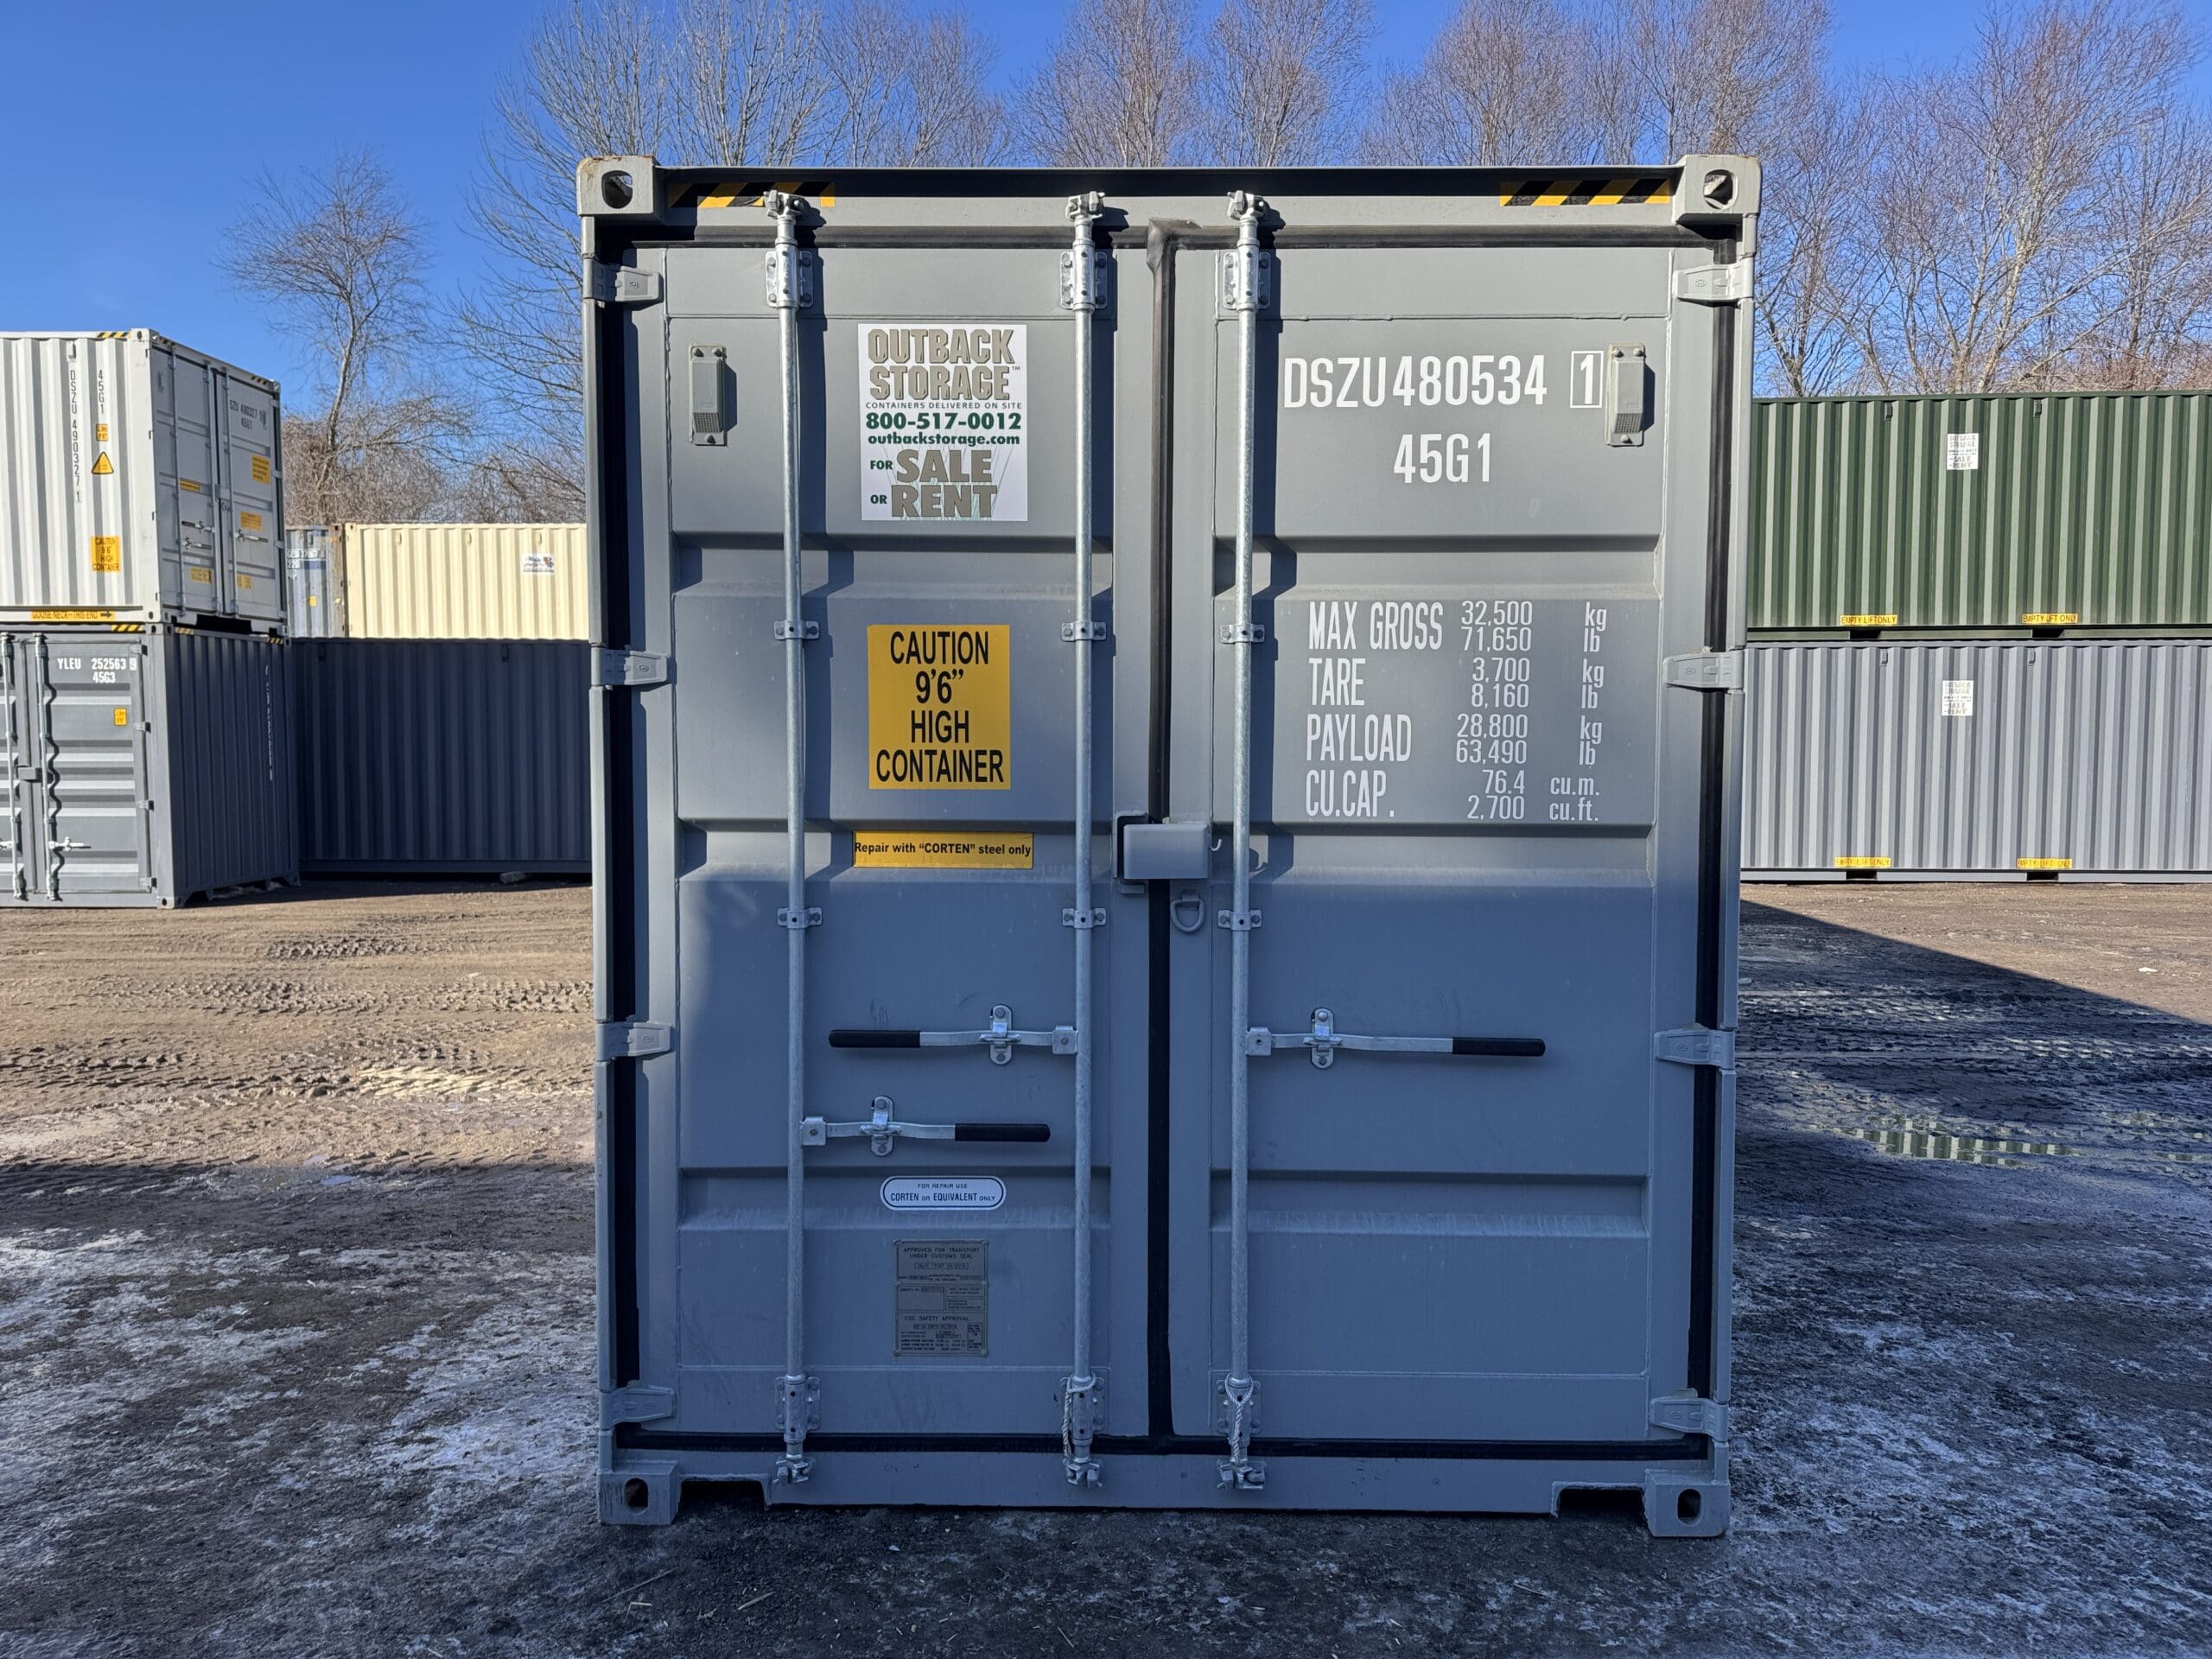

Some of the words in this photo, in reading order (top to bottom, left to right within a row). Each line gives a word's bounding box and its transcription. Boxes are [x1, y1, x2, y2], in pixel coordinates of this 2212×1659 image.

[868, 328, 1015, 364] OUTBACK
[869, 365, 1010, 400] STORAGE
[1580, 354, 1593, 404] 1
[866, 412, 1021, 429] 800-517-0012
[868, 432, 1020, 446] outbackstorage.com
[870, 461, 893, 470] FOR
[896, 449, 993, 483] SALE
[1394, 433, 1491, 483] 45G1
[870, 494, 887, 504] OR
[891, 485, 997, 518] RENT
[1308, 601, 1358, 650] MAX
[1370, 602, 1444, 650] GROSS
[1461, 601, 1533, 626] 32,500
[1585, 602, 1608, 631] kg
[1461, 626, 1532, 652] 71,650
[1583, 627, 1600, 652] lb
[57, 658, 81, 670] YLEU
[91, 658, 126, 670] 252563
[890, 631, 988, 664] CAUTION
[92, 671, 115, 683] 45G3
[1308, 658, 1366, 706] TARE
[1471, 657, 1530, 683] 3,700
[1582, 658, 1605, 688] kg
[1471, 683, 1529, 709] 8,160
[1581, 684, 1599, 709] lb
[911, 710, 969, 743] HIGH
[1306, 714, 1412, 762] PAYLOAD
[1457, 713, 1529, 739] 28,800
[1580, 715, 1603, 744] kg
[876, 749, 1004, 783] CONTAINER
[1456, 740, 1528, 765] 63,490
[1579, 741, 1596, 766] lb
[1482, 769, 1525, 795] 76.4
[1549, 776, 1599, 796] cu.m.
[1467, 795, 1525, 821] 2,700
[1549, 797, 1599, 821] cu.ft.
[855, 842, 889, 854] Repair
[893, 842, 916, 853] with
[978, 843, 1005, 854] steel
[1008, 844, 1032, 856] only
[890, 1192, 918, 1201] CORTEN
[933, 1192, 977, 1201] EQUIVALENT
